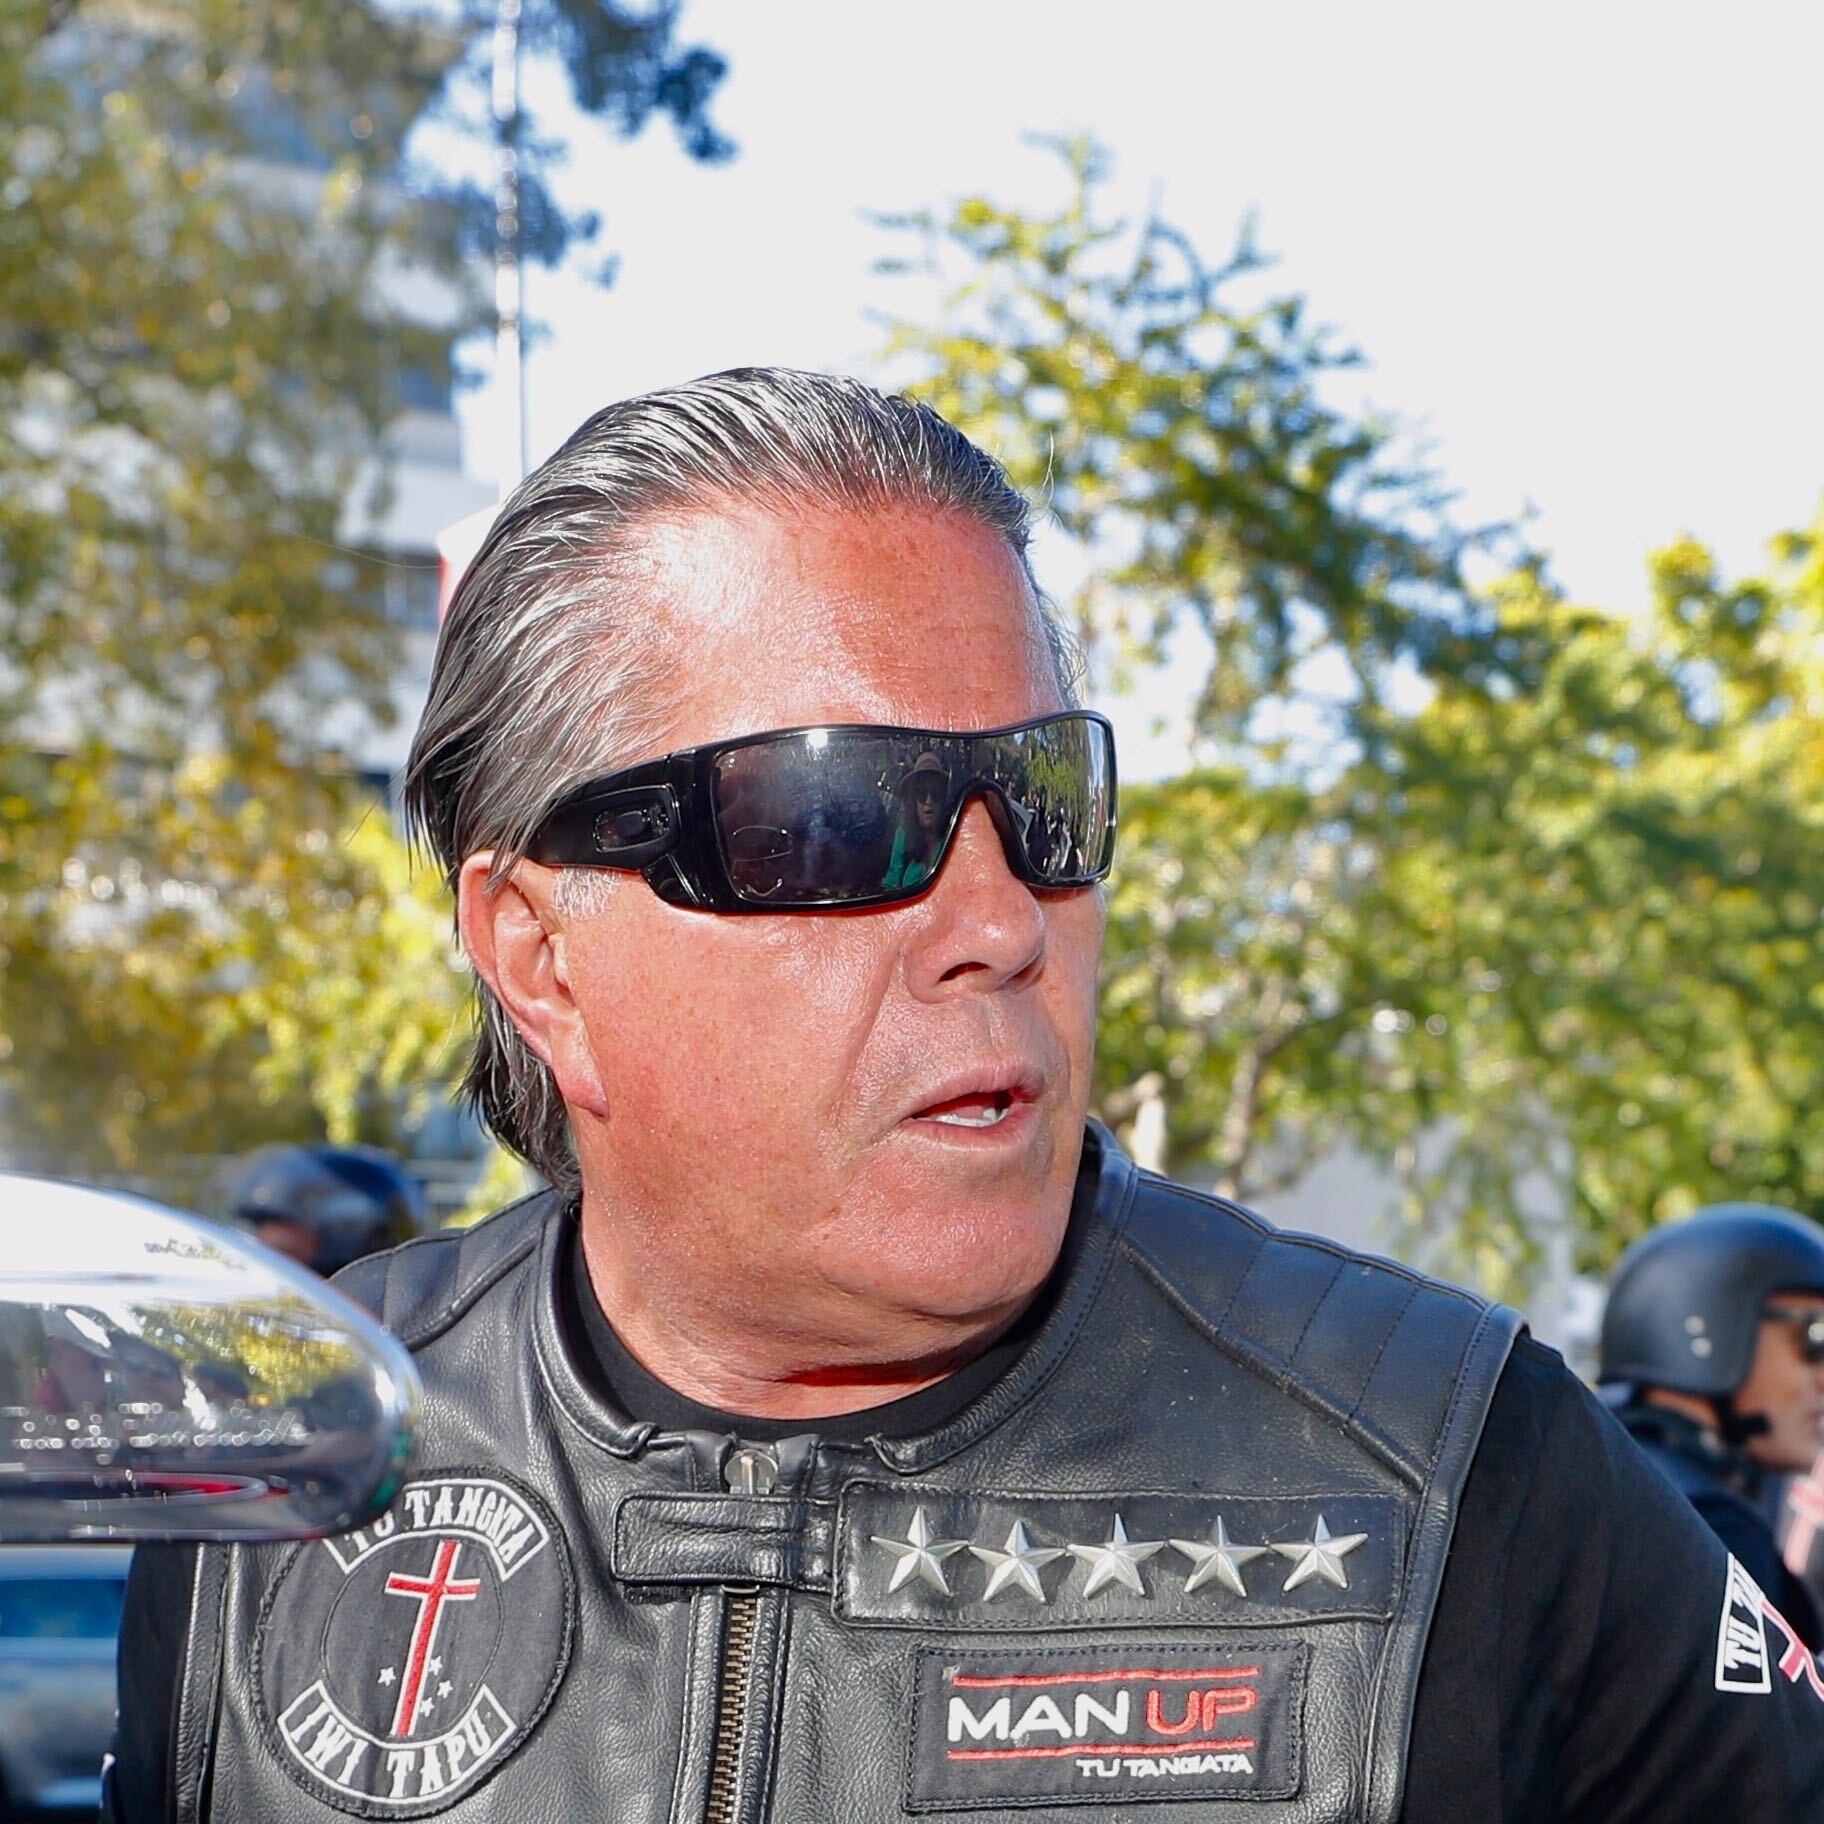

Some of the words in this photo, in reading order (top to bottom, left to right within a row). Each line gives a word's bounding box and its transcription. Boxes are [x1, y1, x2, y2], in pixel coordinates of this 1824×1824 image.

[404, 1486, 537, 1564] TANGATA
[946, 1689, 1131, 1742] MAN
[1144, 1685, 1258, 1737] UP
[289, 1701, 370, 1787] IWI
[386, 1709, 493, 1799] TAPU
[1075, 1758, 1121, 1778] TU
[1122, 1753, 1255, 1778] TANGATA
